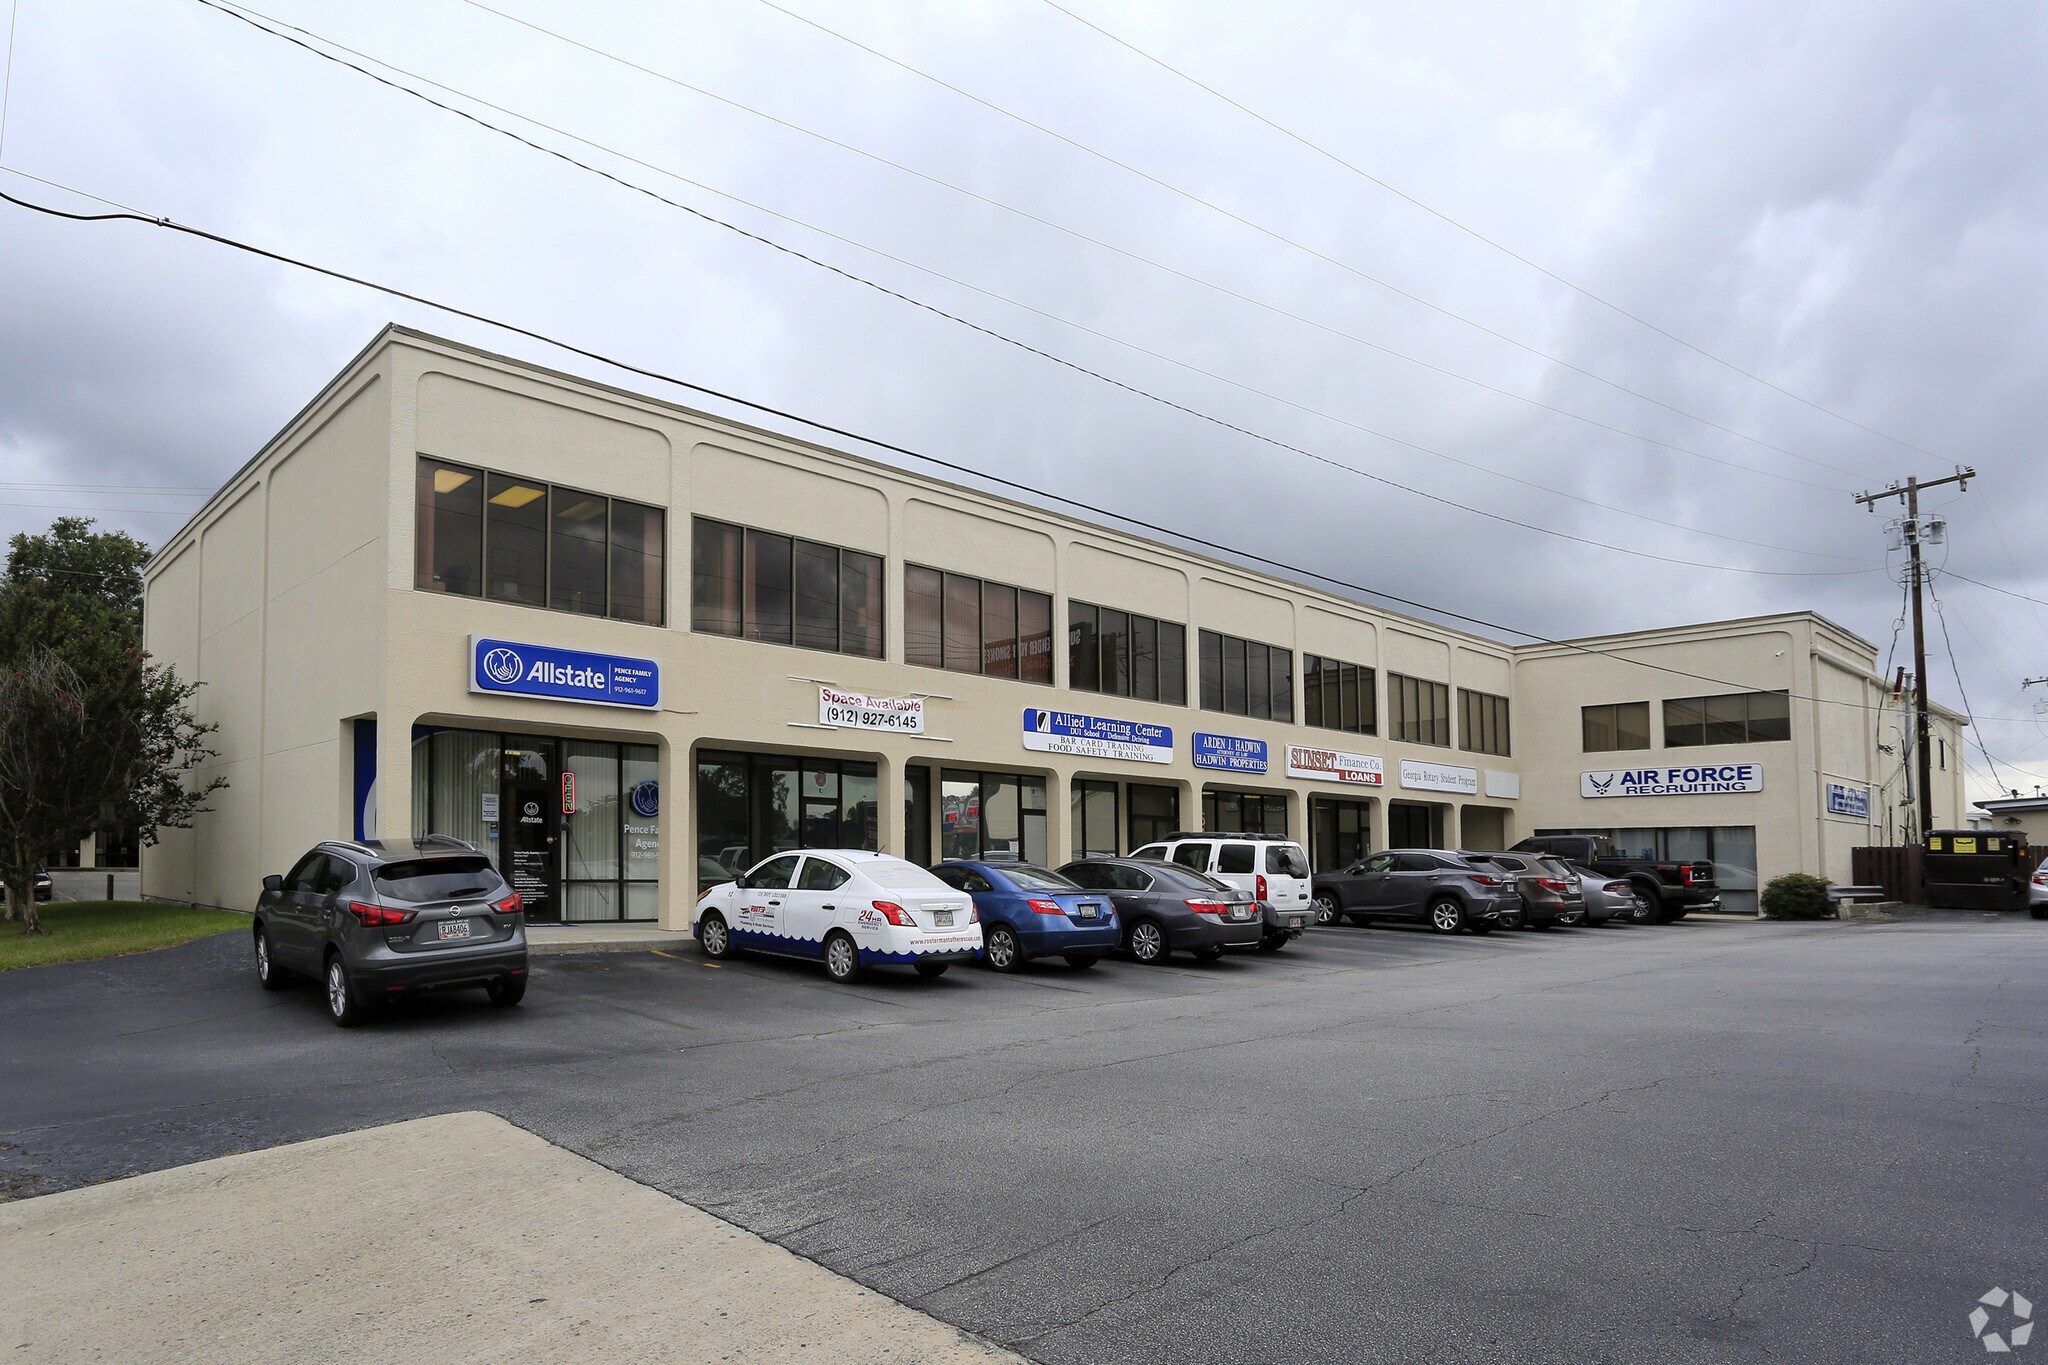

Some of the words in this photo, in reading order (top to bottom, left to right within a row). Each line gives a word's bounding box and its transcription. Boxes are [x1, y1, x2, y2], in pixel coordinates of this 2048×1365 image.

[526, 661, 605, 689] Allstate
[614, 667, 632, 675] PENCE
[632, 669, 652, 677] FAMILY
[822, 689, 863, 706] Space
[866, 696, 921, 712] Available
[827, 707, 858, 726] (912)
[862, 712, 917, 729] 927-6145
[1055, 713, 1085, 728] Allied
[1090, 717, 1131, 735] Learning
[1135, 724, 1163, 738] Center
[1060, 736, 1076, 746] BAR
[1080, 738, 1103, 748] CARD
[1107, 741, 1144, 752] TRAINING
[1070, 728, 1082, 736] DUI
[1084, 729, 1100, 738] School
[1107, 732, 1130, 742] Defensive
[1131, 735, 1150, 745] Driving
[1203, 735, 1227, 750] ARDEN
[1228, 738, 1234, 750] J.
[1235, 740, 1261, 753] HADWIN
[1048, 743, 1072, 753] FOOD
[1076, 746, 1108, 757] SAFETY
[1114, 750, 1154, 761] TRAINING
[1290, 747, 1337, 772] SUNSET
[1339, 755, 1368, 770] Finance
[1370, 759, 1382, 771] Co.
[1196, 754, 1227, 766] HADWIN
[1229, 758, 1268, 770] PROPERTIES
[1345, 771, 1376, 783] LOANS
[1402, 768, 1421, 782] Georgia
[1423, 771, 1439, 784] Rotary
[1440, 773, 1456, 784] Student
[1458, 775, 1476, 787] Program
[1620, 770, 1660, 786] AIR
[1668, 765, 1752, 784] FORCE
[1626, 781, 1746, 794] RECRUITING
[520, 816, 543, 824] Allstate
[624, 824, 649, 834] Pence
[635, 838, 659, 850] Agen
[630, 851, 659, 859] 912-961-9
